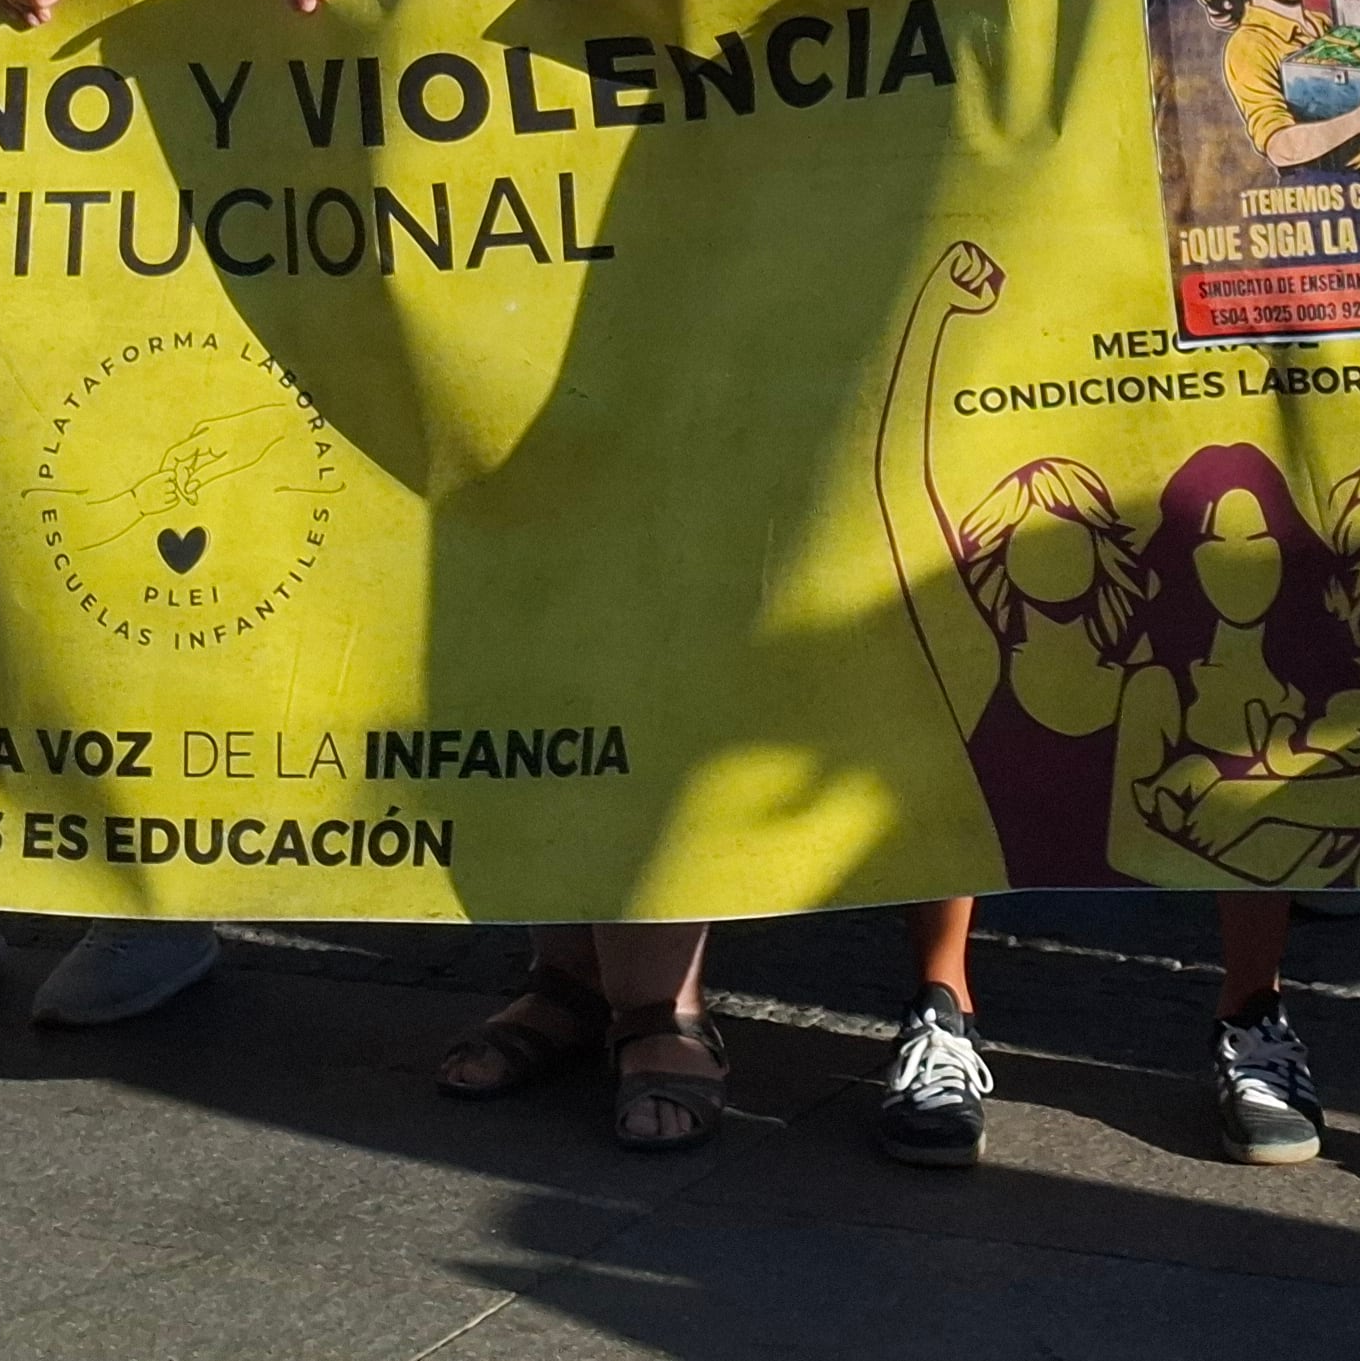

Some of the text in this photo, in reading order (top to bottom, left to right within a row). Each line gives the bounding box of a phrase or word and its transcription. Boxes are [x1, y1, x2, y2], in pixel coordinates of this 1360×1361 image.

[187, 60, 253, 151] Y
[1241, 183, 1345, 218] ¡TENEMOS
[1180, 224, 1243, 266] ¡QUE
[1248, 220, 1315, 259] SIGA
[1321, 216, 1359, 255] LA
[1198, 276, 1274, 300] SINDICATO
[1277, 274, 1296, 294] DE
[1210, 306, 1249, 326] ES04
[1252, 303, 1293, 324] 3025
[1296, 302, 1337, 322] 0003
[38, 330, 336, 481] PLATAFORMA LABORAL
[952, 369, 1226, 417] CONDICIONES
[41, 507, 331, 650] ESCUELAS INFANTILES
[143, 585, 220, 607] PLEI
[35, 728, 153, 779] VOZ
[181, 730, 255, 779] DE
[275, 730, 347, 781] LA
[363, 724, 632, 782] INFANCIA
[21, 812, 90, 863] ES
[104, 804, 456, 870] EDUCACIÓN
